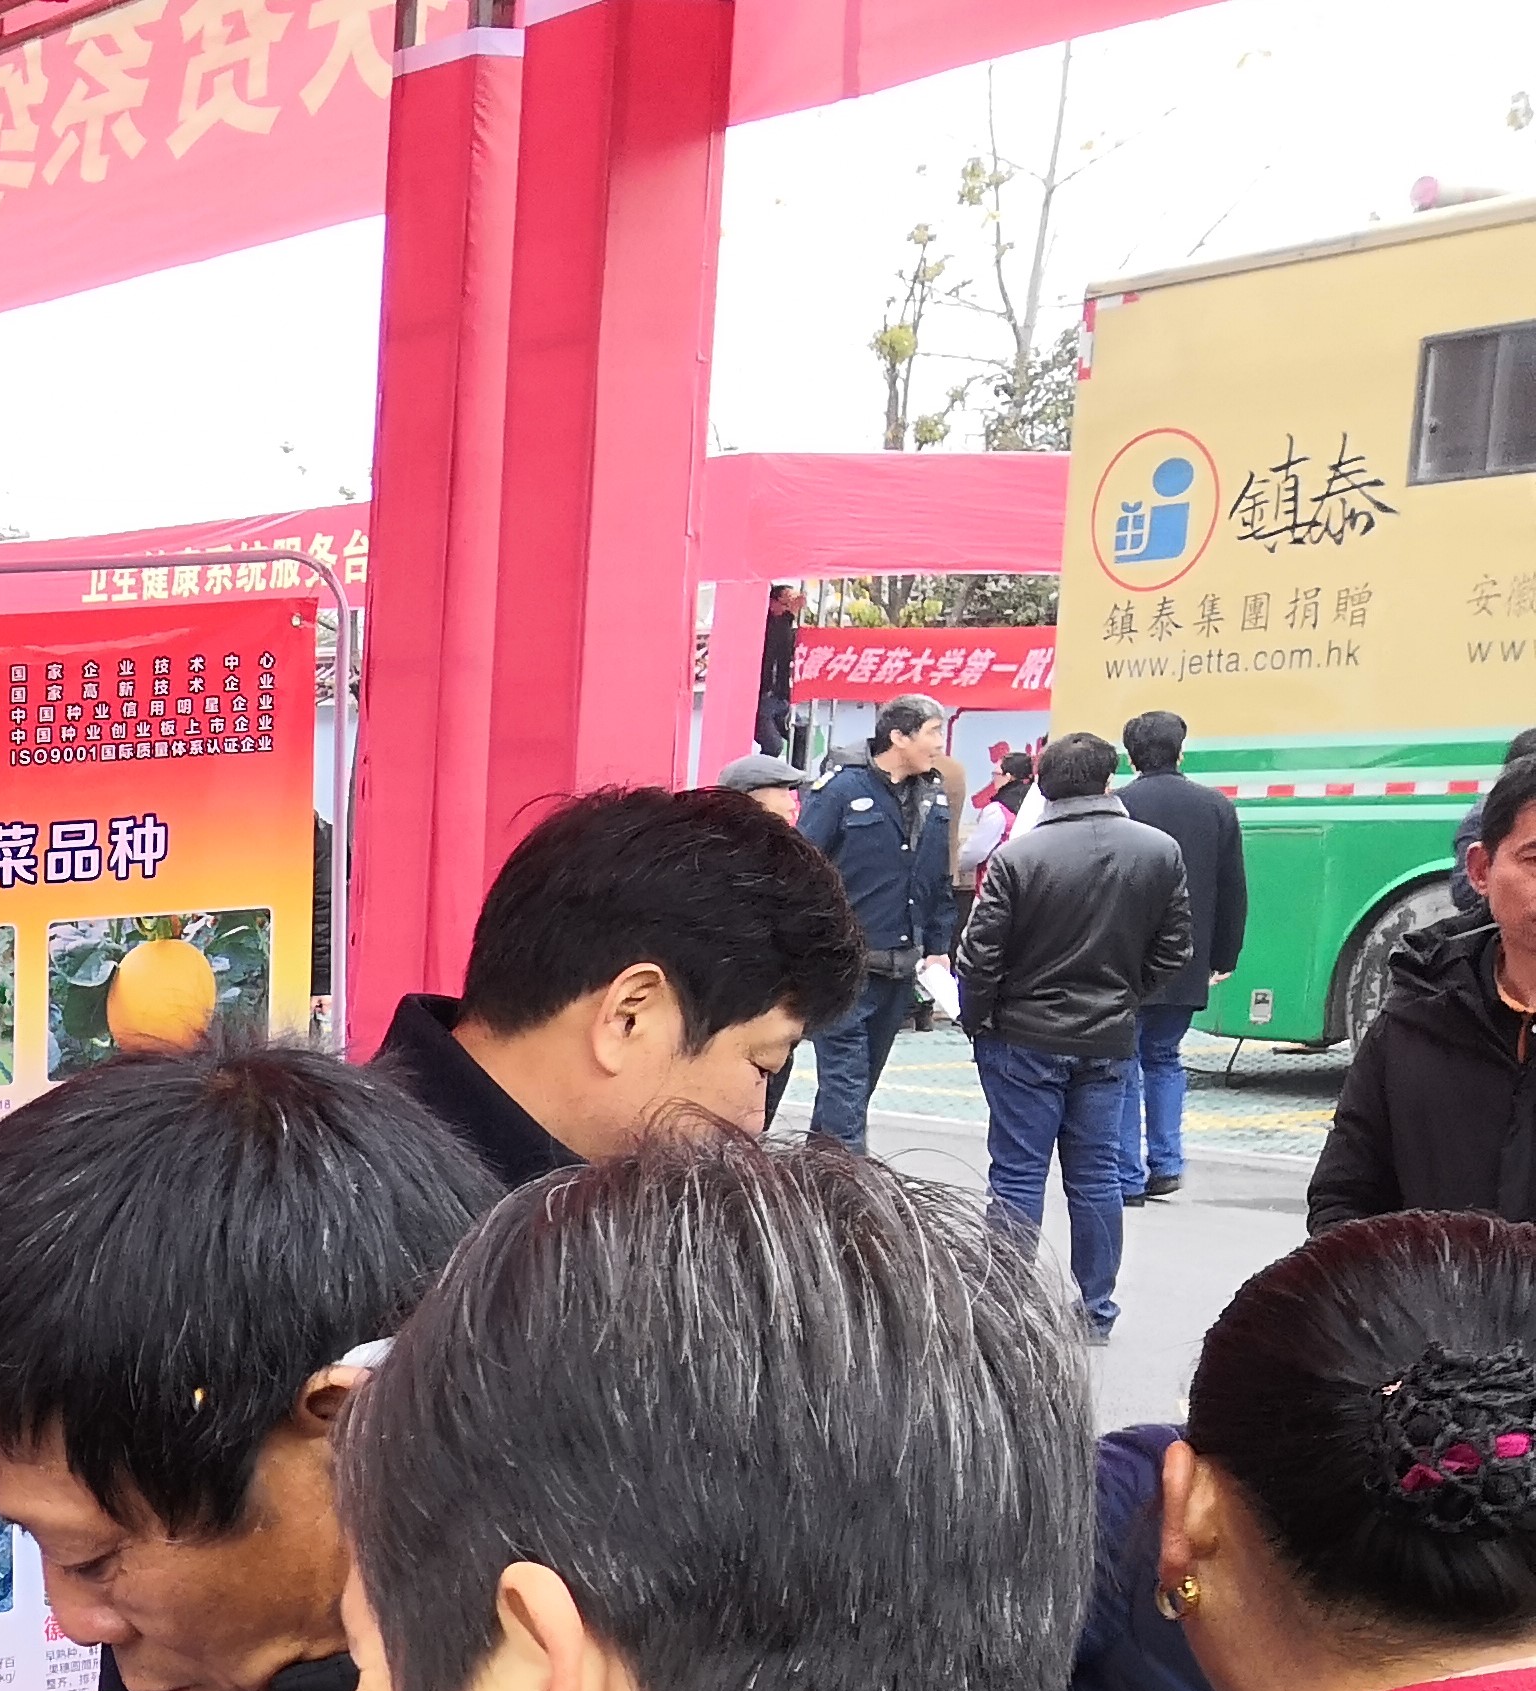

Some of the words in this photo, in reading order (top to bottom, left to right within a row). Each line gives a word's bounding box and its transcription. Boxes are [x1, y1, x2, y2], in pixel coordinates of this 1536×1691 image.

[81, 528, 370, 604] 卫生健康系统服务台
[1102, 583, 1374, 645] 鎮泰集團捐贈
[792, 643, 1055, 690] 安徽中医药大学第一附
[1105, 639, 1360, 682] www.jetta.com.hk
[1466, 638, 1536, 664] ww
[9, 652, 275, 683] 国家企业技术中心
[10, 672, 275, 704] 国家高新技术企业
[11, 694, 273, 724] 中国种业信用明星企业
[11, 715, 273, 745] 中国种业创业板上市企业
[10, 735, 273, 766] ISO9001国际质量体系认证企业
